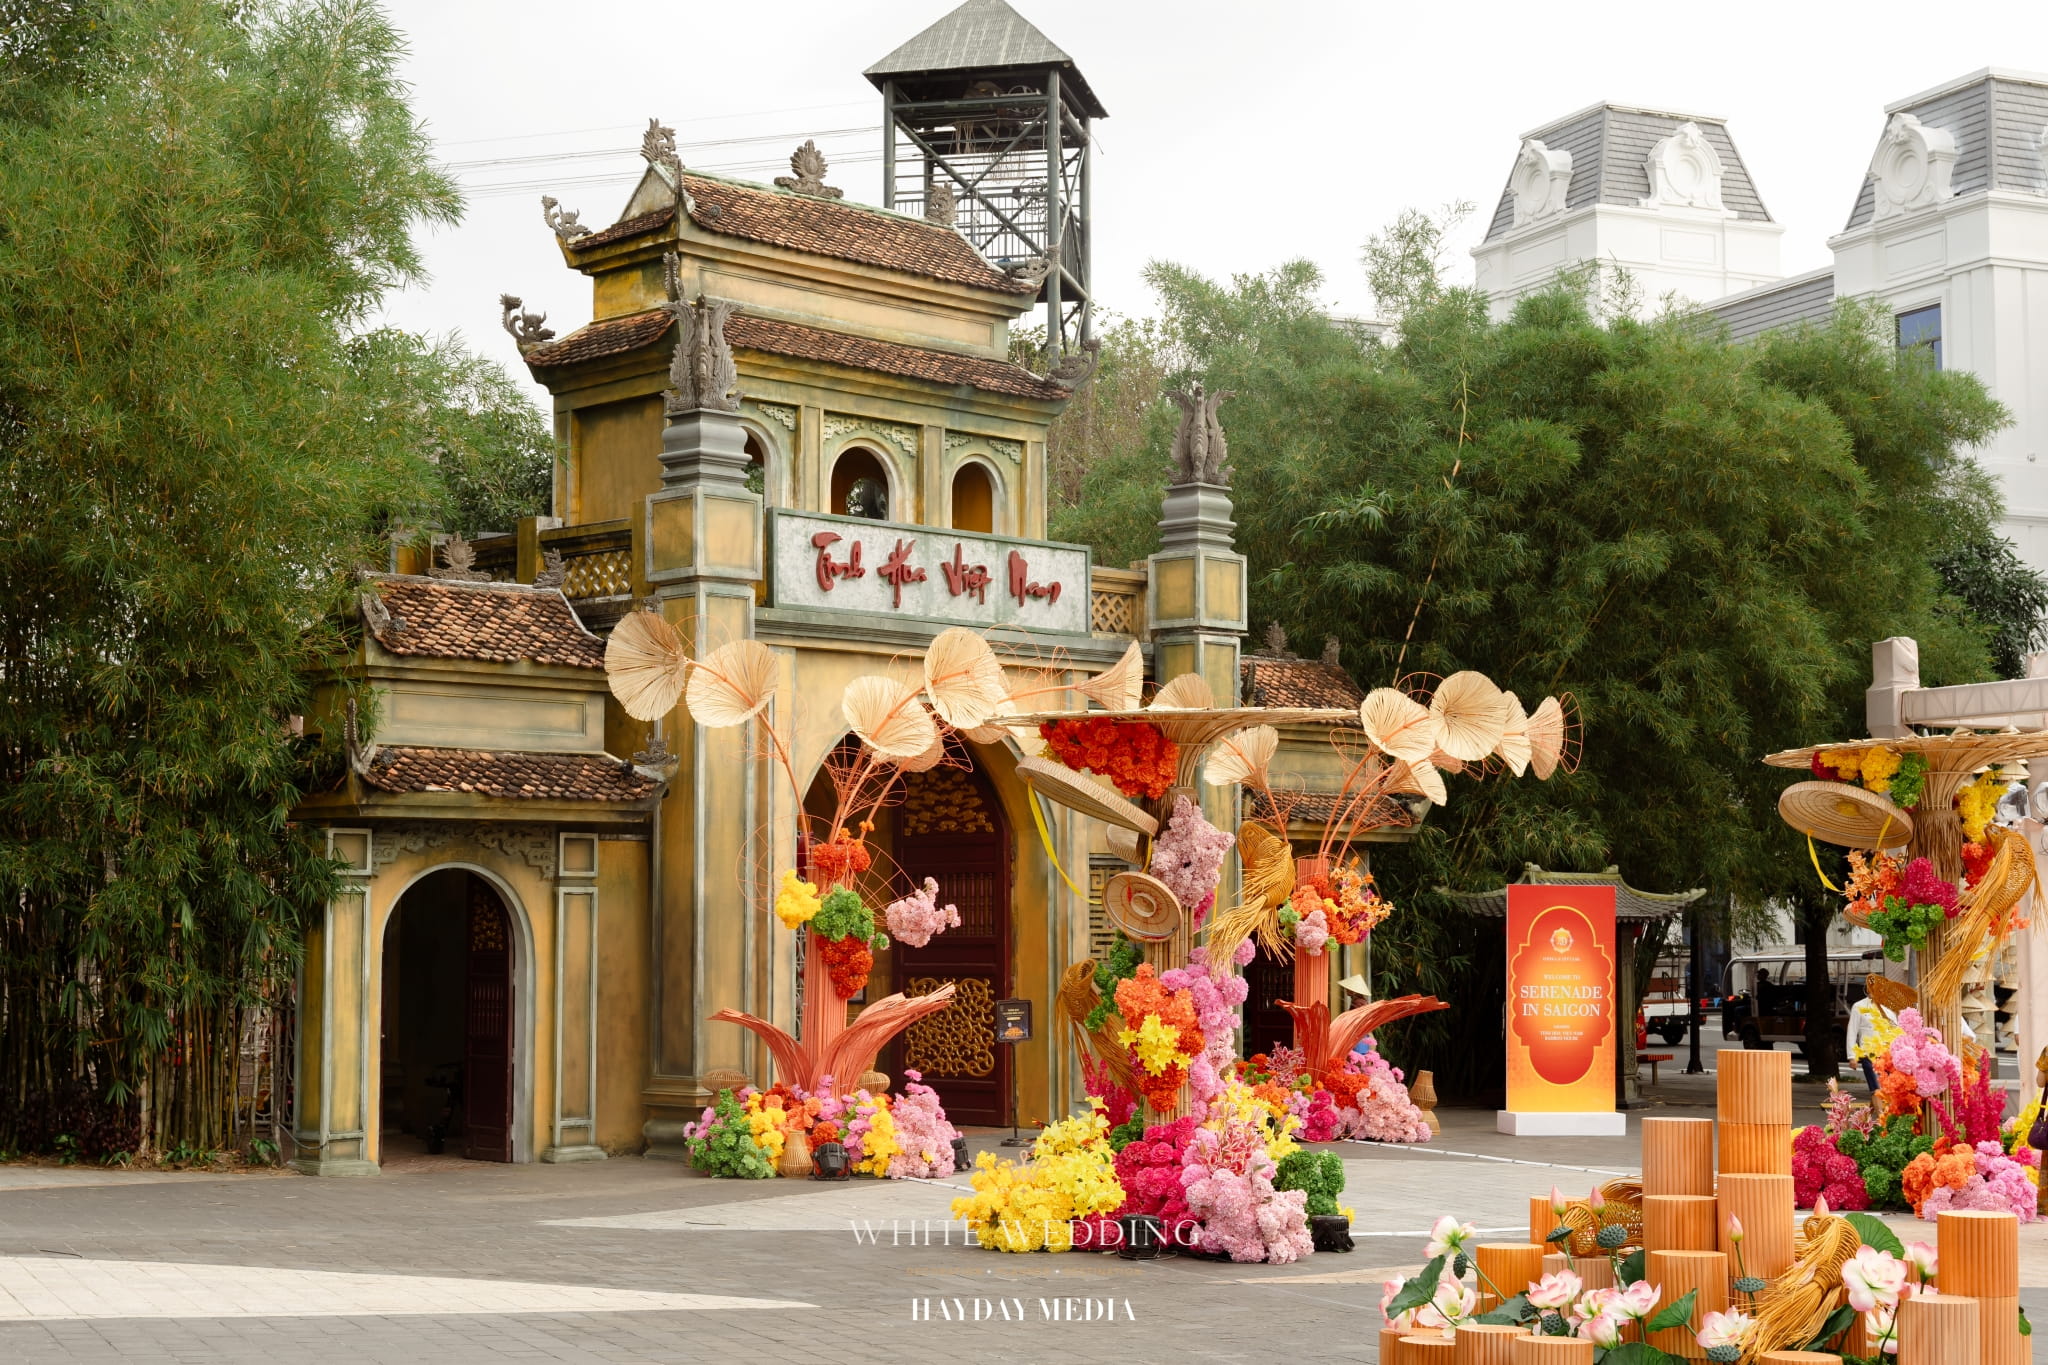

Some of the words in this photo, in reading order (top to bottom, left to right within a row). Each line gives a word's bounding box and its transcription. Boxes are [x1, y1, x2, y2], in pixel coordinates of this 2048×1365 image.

[1520, 985, 1602, 999] SERENADE
[1522, 1003, 1540, 1017] IN
[1543, 1003, 1601, 1017] SAIGON
